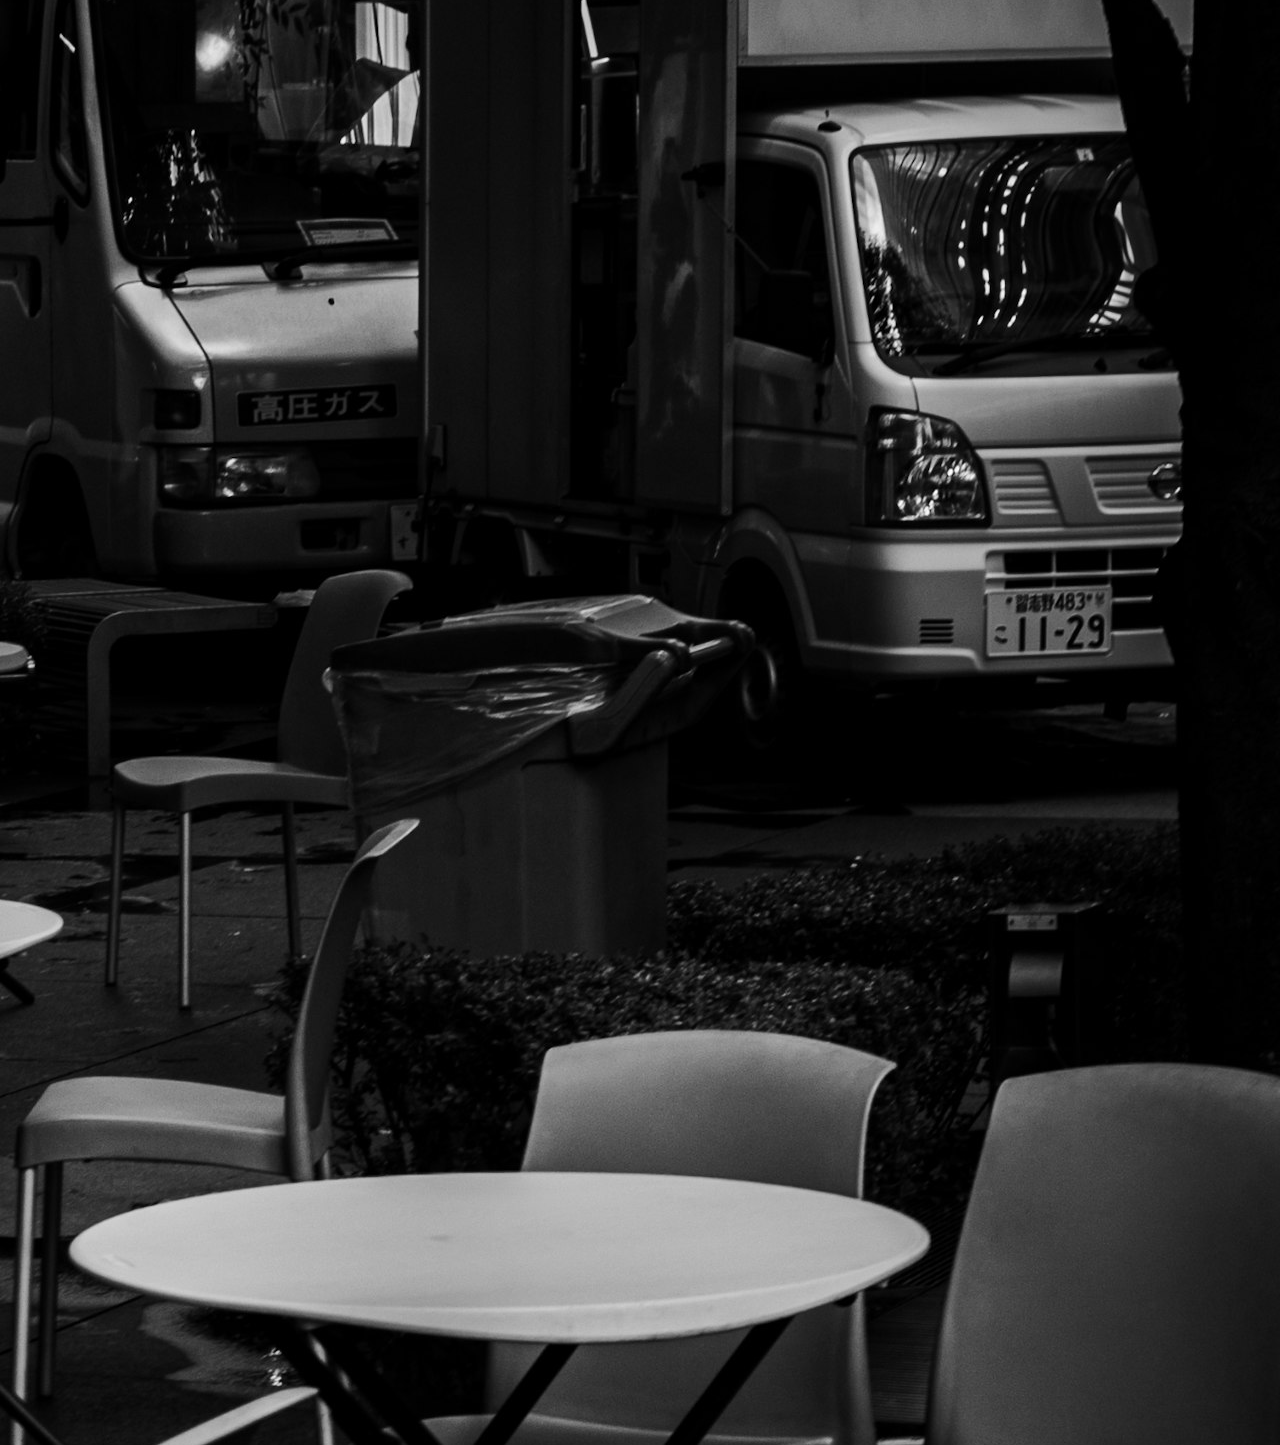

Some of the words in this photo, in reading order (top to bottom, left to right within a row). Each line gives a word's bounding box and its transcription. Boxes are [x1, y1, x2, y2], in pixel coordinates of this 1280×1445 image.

[251, 389, 385, 424] 高圧ガス
[1018, 614, 1105, 651] 11-29
